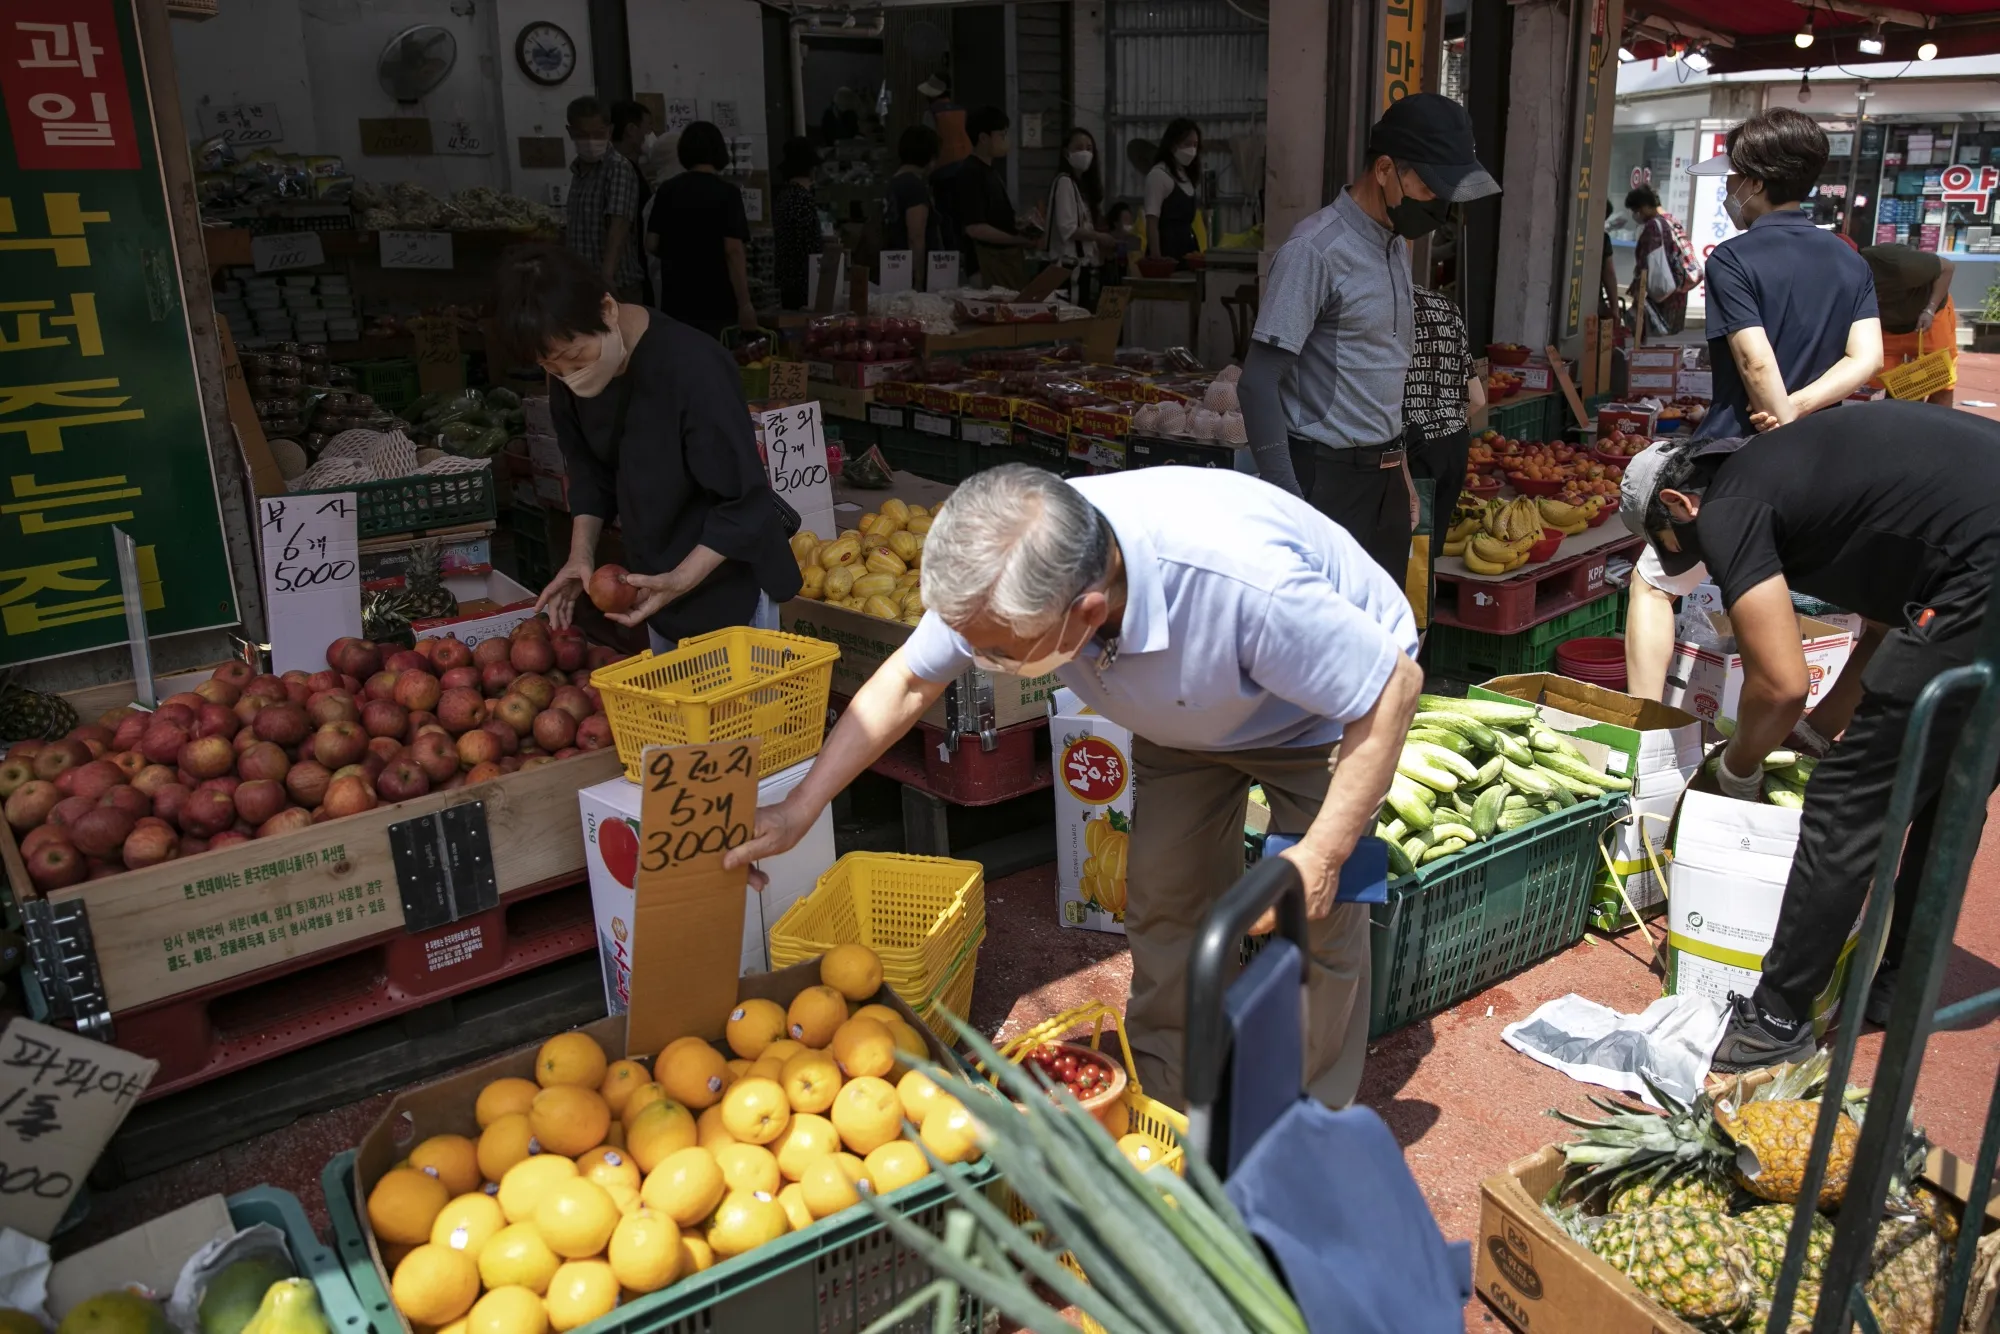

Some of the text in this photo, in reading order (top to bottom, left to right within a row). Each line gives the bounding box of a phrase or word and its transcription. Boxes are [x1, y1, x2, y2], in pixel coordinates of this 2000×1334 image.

[16, 21, 116, 147] 과일
[1940, 165, 2000, 214] 약
[767, 407, 815, 447] 참외
[263, 499, 357, 533] 부사
[283, 522, 327, 561] 6개
[1588, 564, 1604, 582] KPP
[650, 745, 752, 793] 오렌지
[585, 811, 597, 844] 10kg
[669, 787, 734, 830] 5개
[184, 883, 196, 900] 본
[196, 871, 243, 896] 컨테이너는
[163, 934, 183, 952] 당사
[187, 922, 225, 945] 허락없이
[274, 903, 293, 921] 임대
[337, 884, 364, 903] 사용할
[367, 878, 384, 896] 경우
[268, 926, 287, 944] 등의
[336, 905, 354, 923] 받을
[356, 902, 366, 918] 수
[368, 897, 387, 915] 있음
[3, 1034, 146, 1105] 파파야
[1490, 1281, 1531, 1328] GOLD
